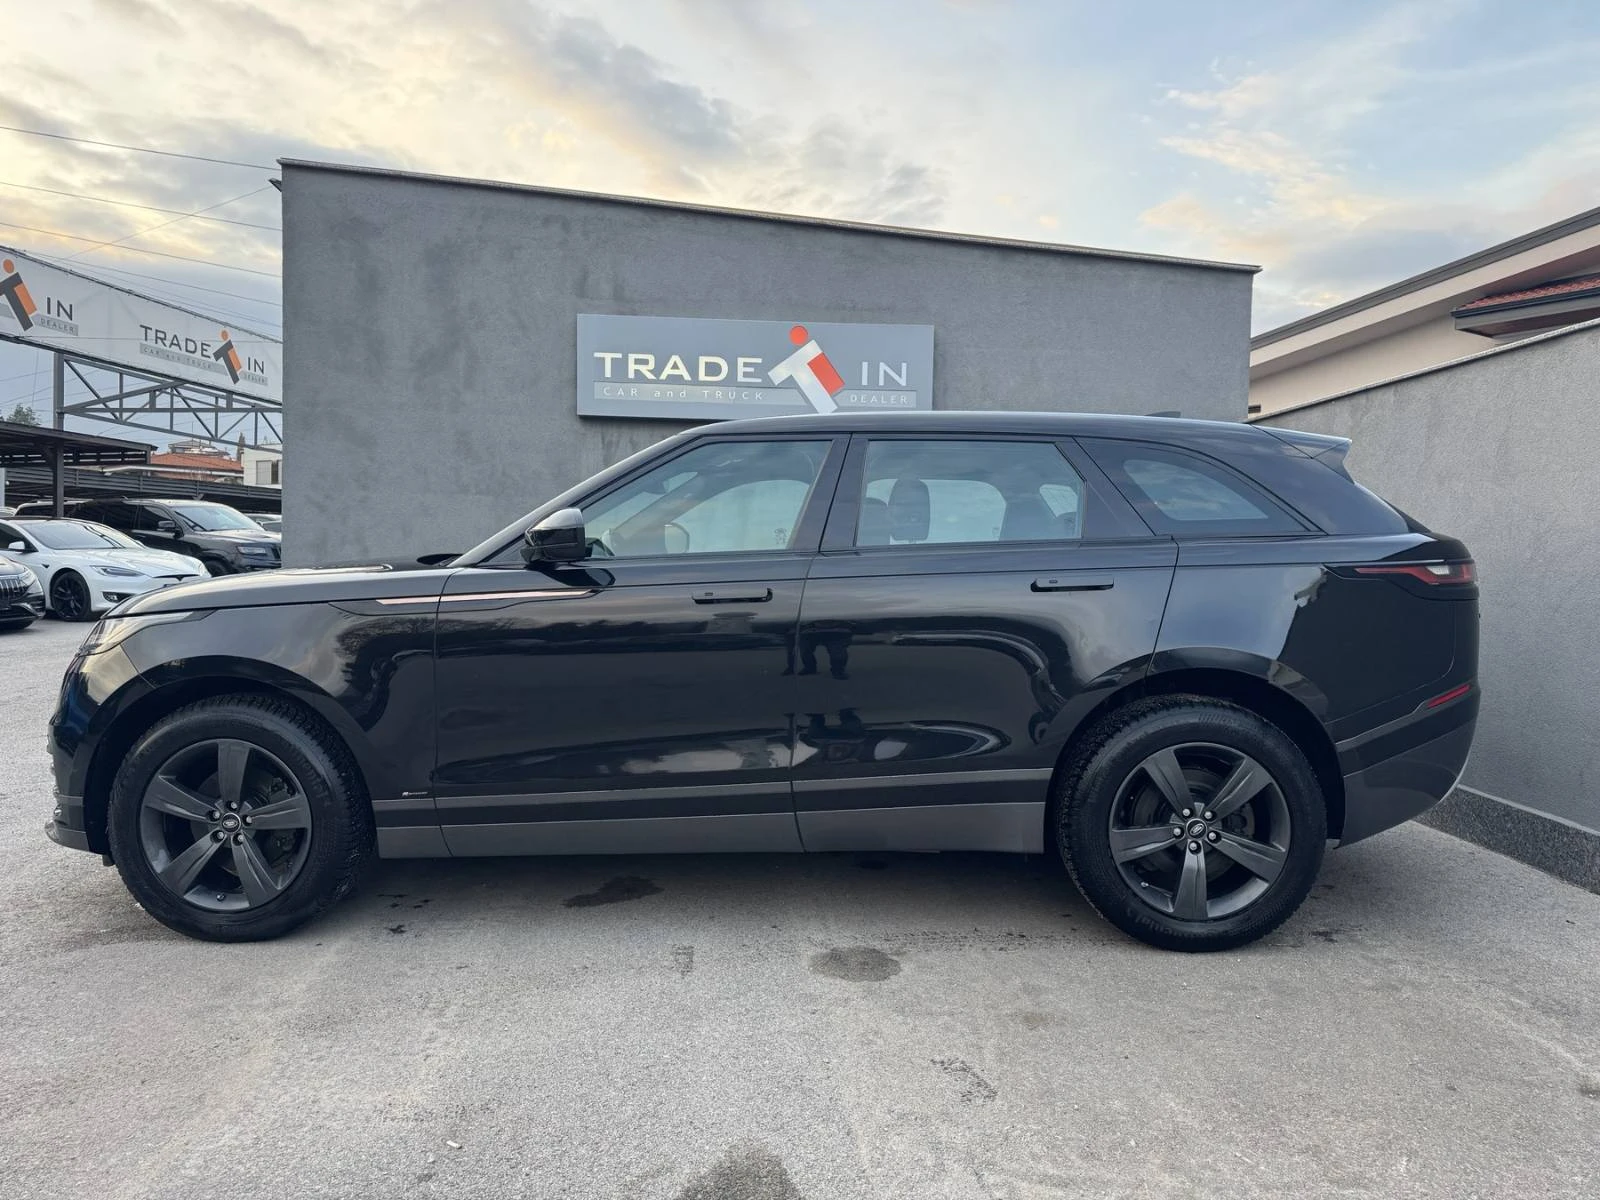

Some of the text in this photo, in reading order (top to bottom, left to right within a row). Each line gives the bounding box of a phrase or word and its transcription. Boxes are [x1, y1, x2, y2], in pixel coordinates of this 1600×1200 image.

[46, 296, 73, 321] IN
[40, 316, 74, 334] DEALER
[139, 324, 212, 359] TRADE
[247, 356, 265, 374] IN
[593, 351, 763, 384] TRADE
[861, 361, 907, 387] IN
[602, 386, 763, 400] CAR and TRUCK
[849, 394, 908, 405] DEALER
